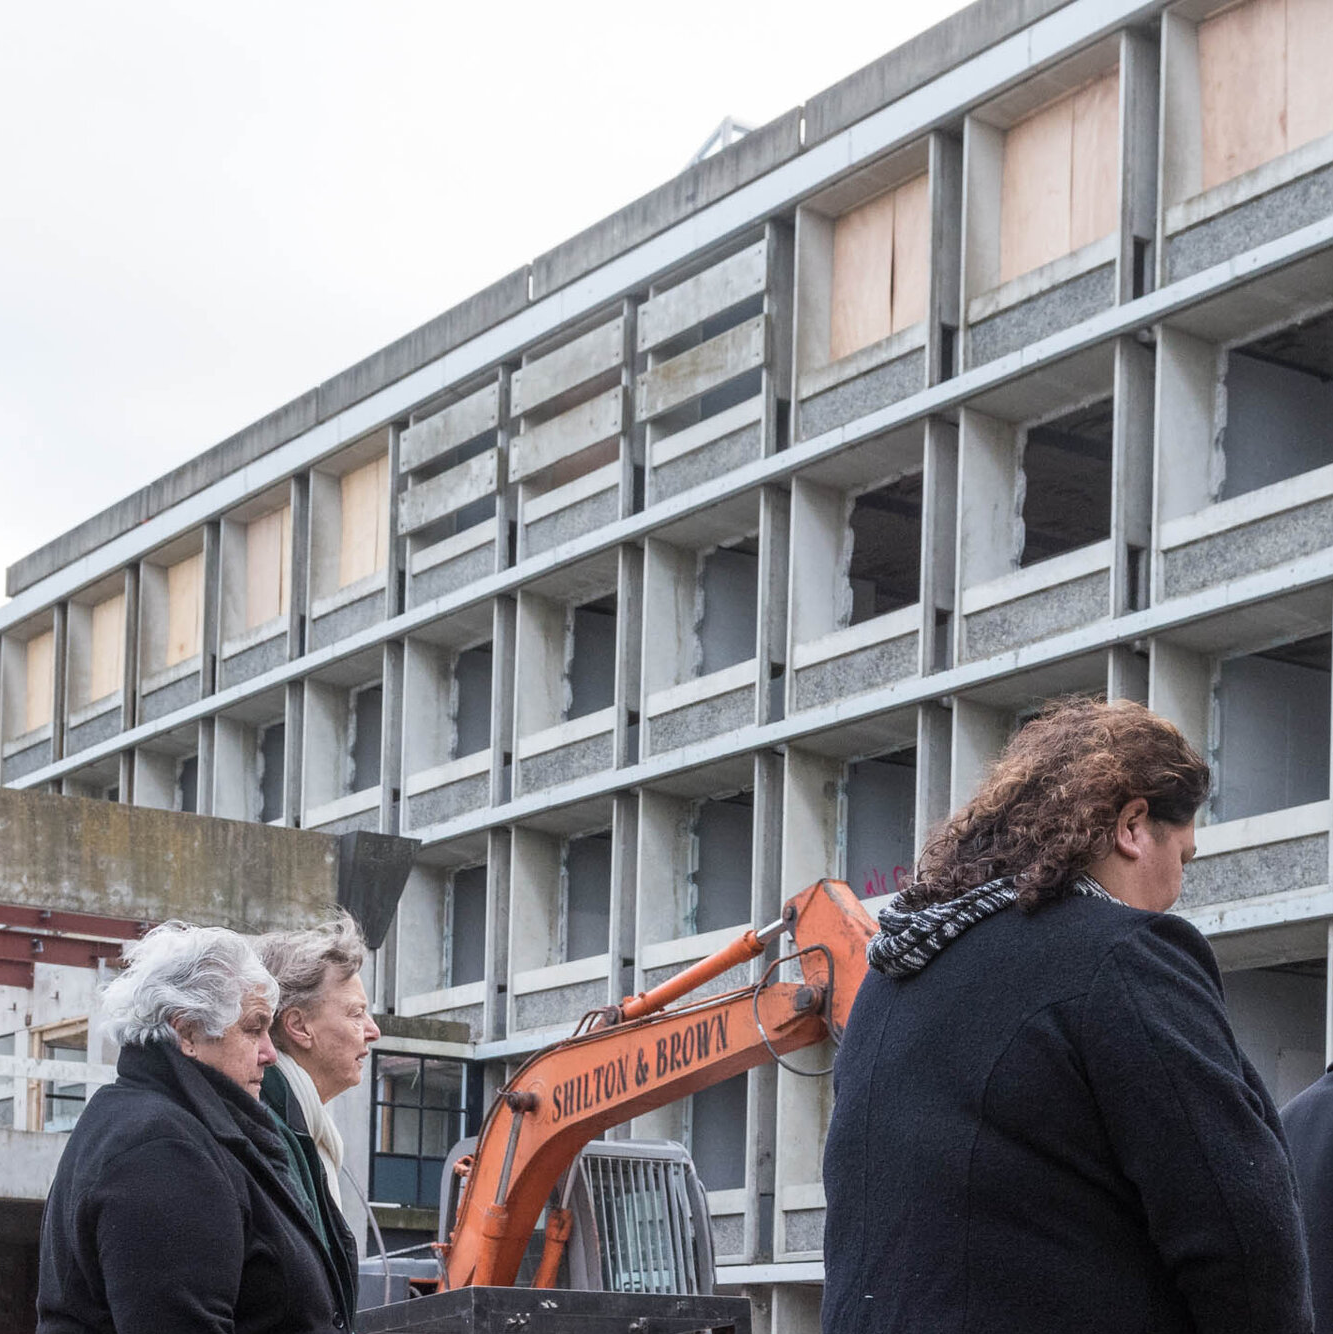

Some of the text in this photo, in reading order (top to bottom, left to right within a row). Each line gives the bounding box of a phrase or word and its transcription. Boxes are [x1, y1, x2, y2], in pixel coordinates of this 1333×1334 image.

[552, 1010, 729, 1123] SHILTON & BROWN
